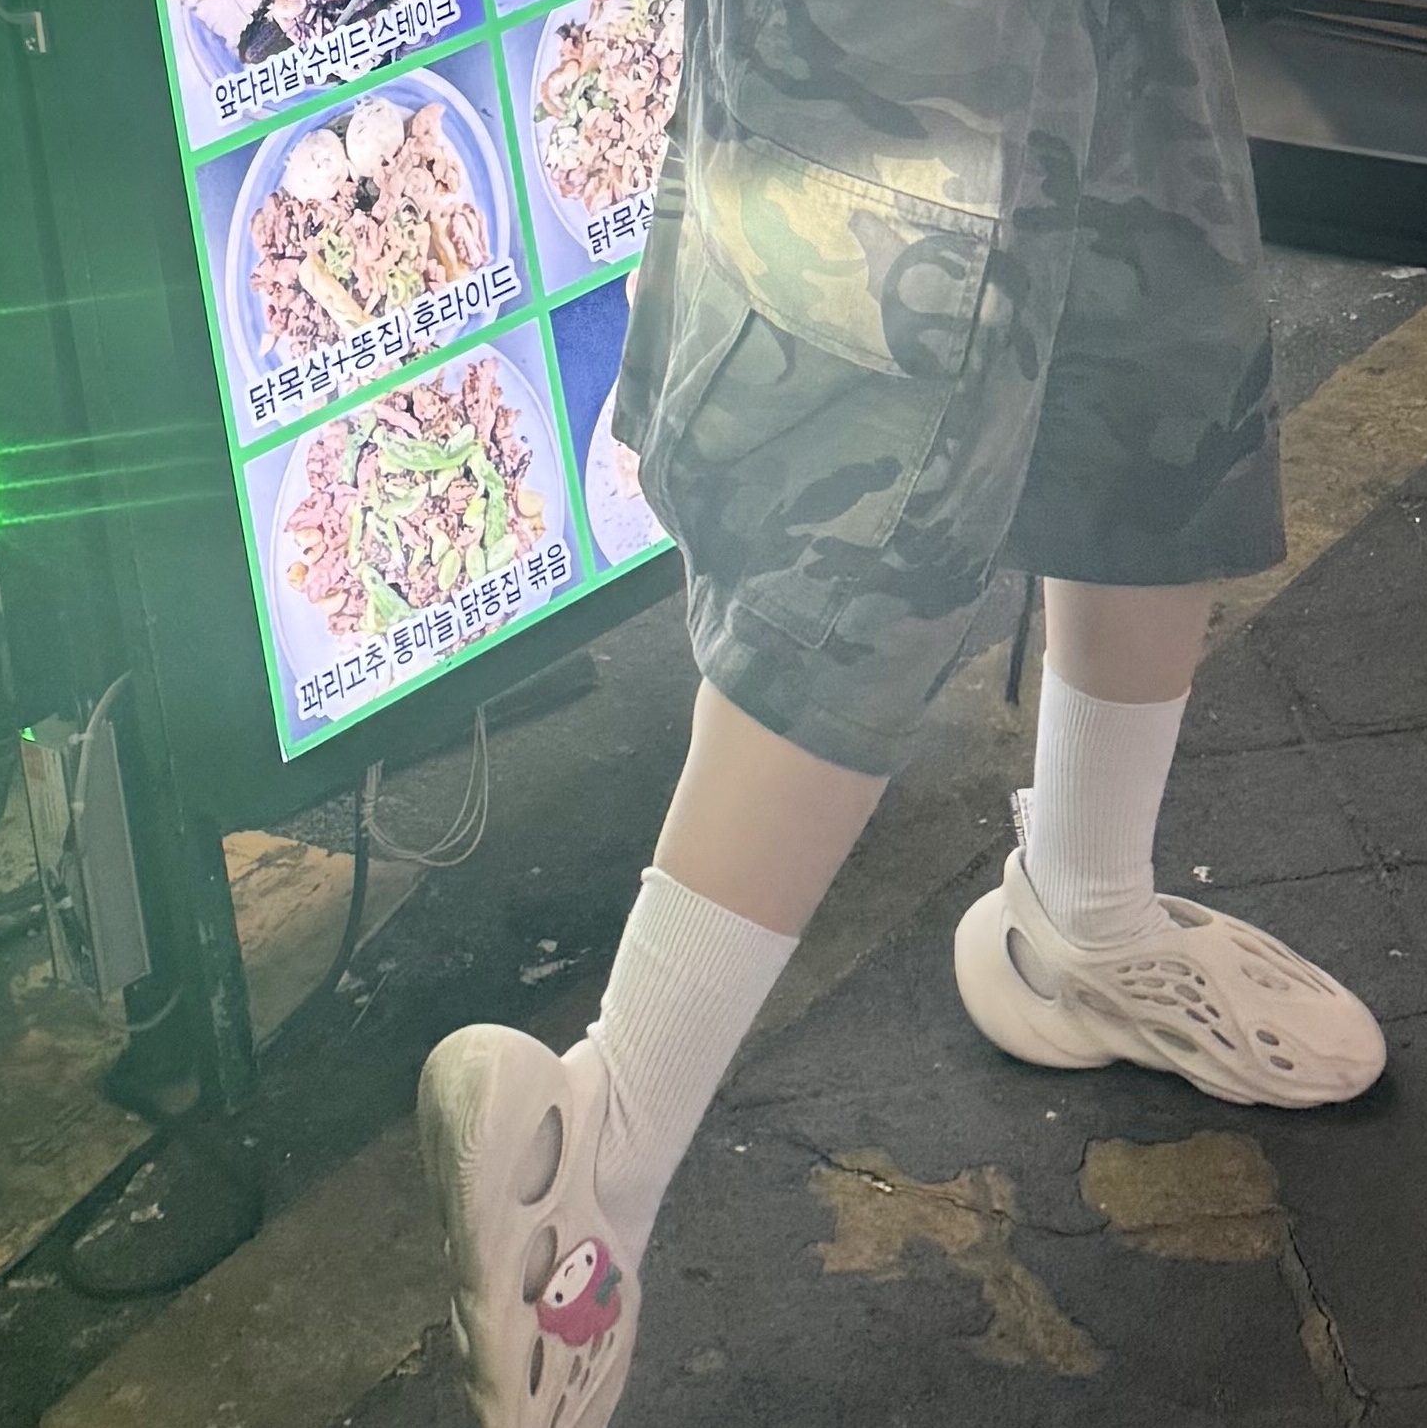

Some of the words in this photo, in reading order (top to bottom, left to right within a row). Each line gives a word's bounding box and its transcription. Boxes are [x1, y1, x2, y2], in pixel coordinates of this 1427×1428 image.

[215, 53, 299, 118] 앞다리살
[302, 27, 373, 78] 수비드
[413, 263, 518, 337] 후라이드
[301, 645, 388, 714] 꽈리고추
[392, 611, 454, 665] 통마늘
[459, 573, 522, 627] 닭똥집
[525, 544, 568, 592] 볶음
